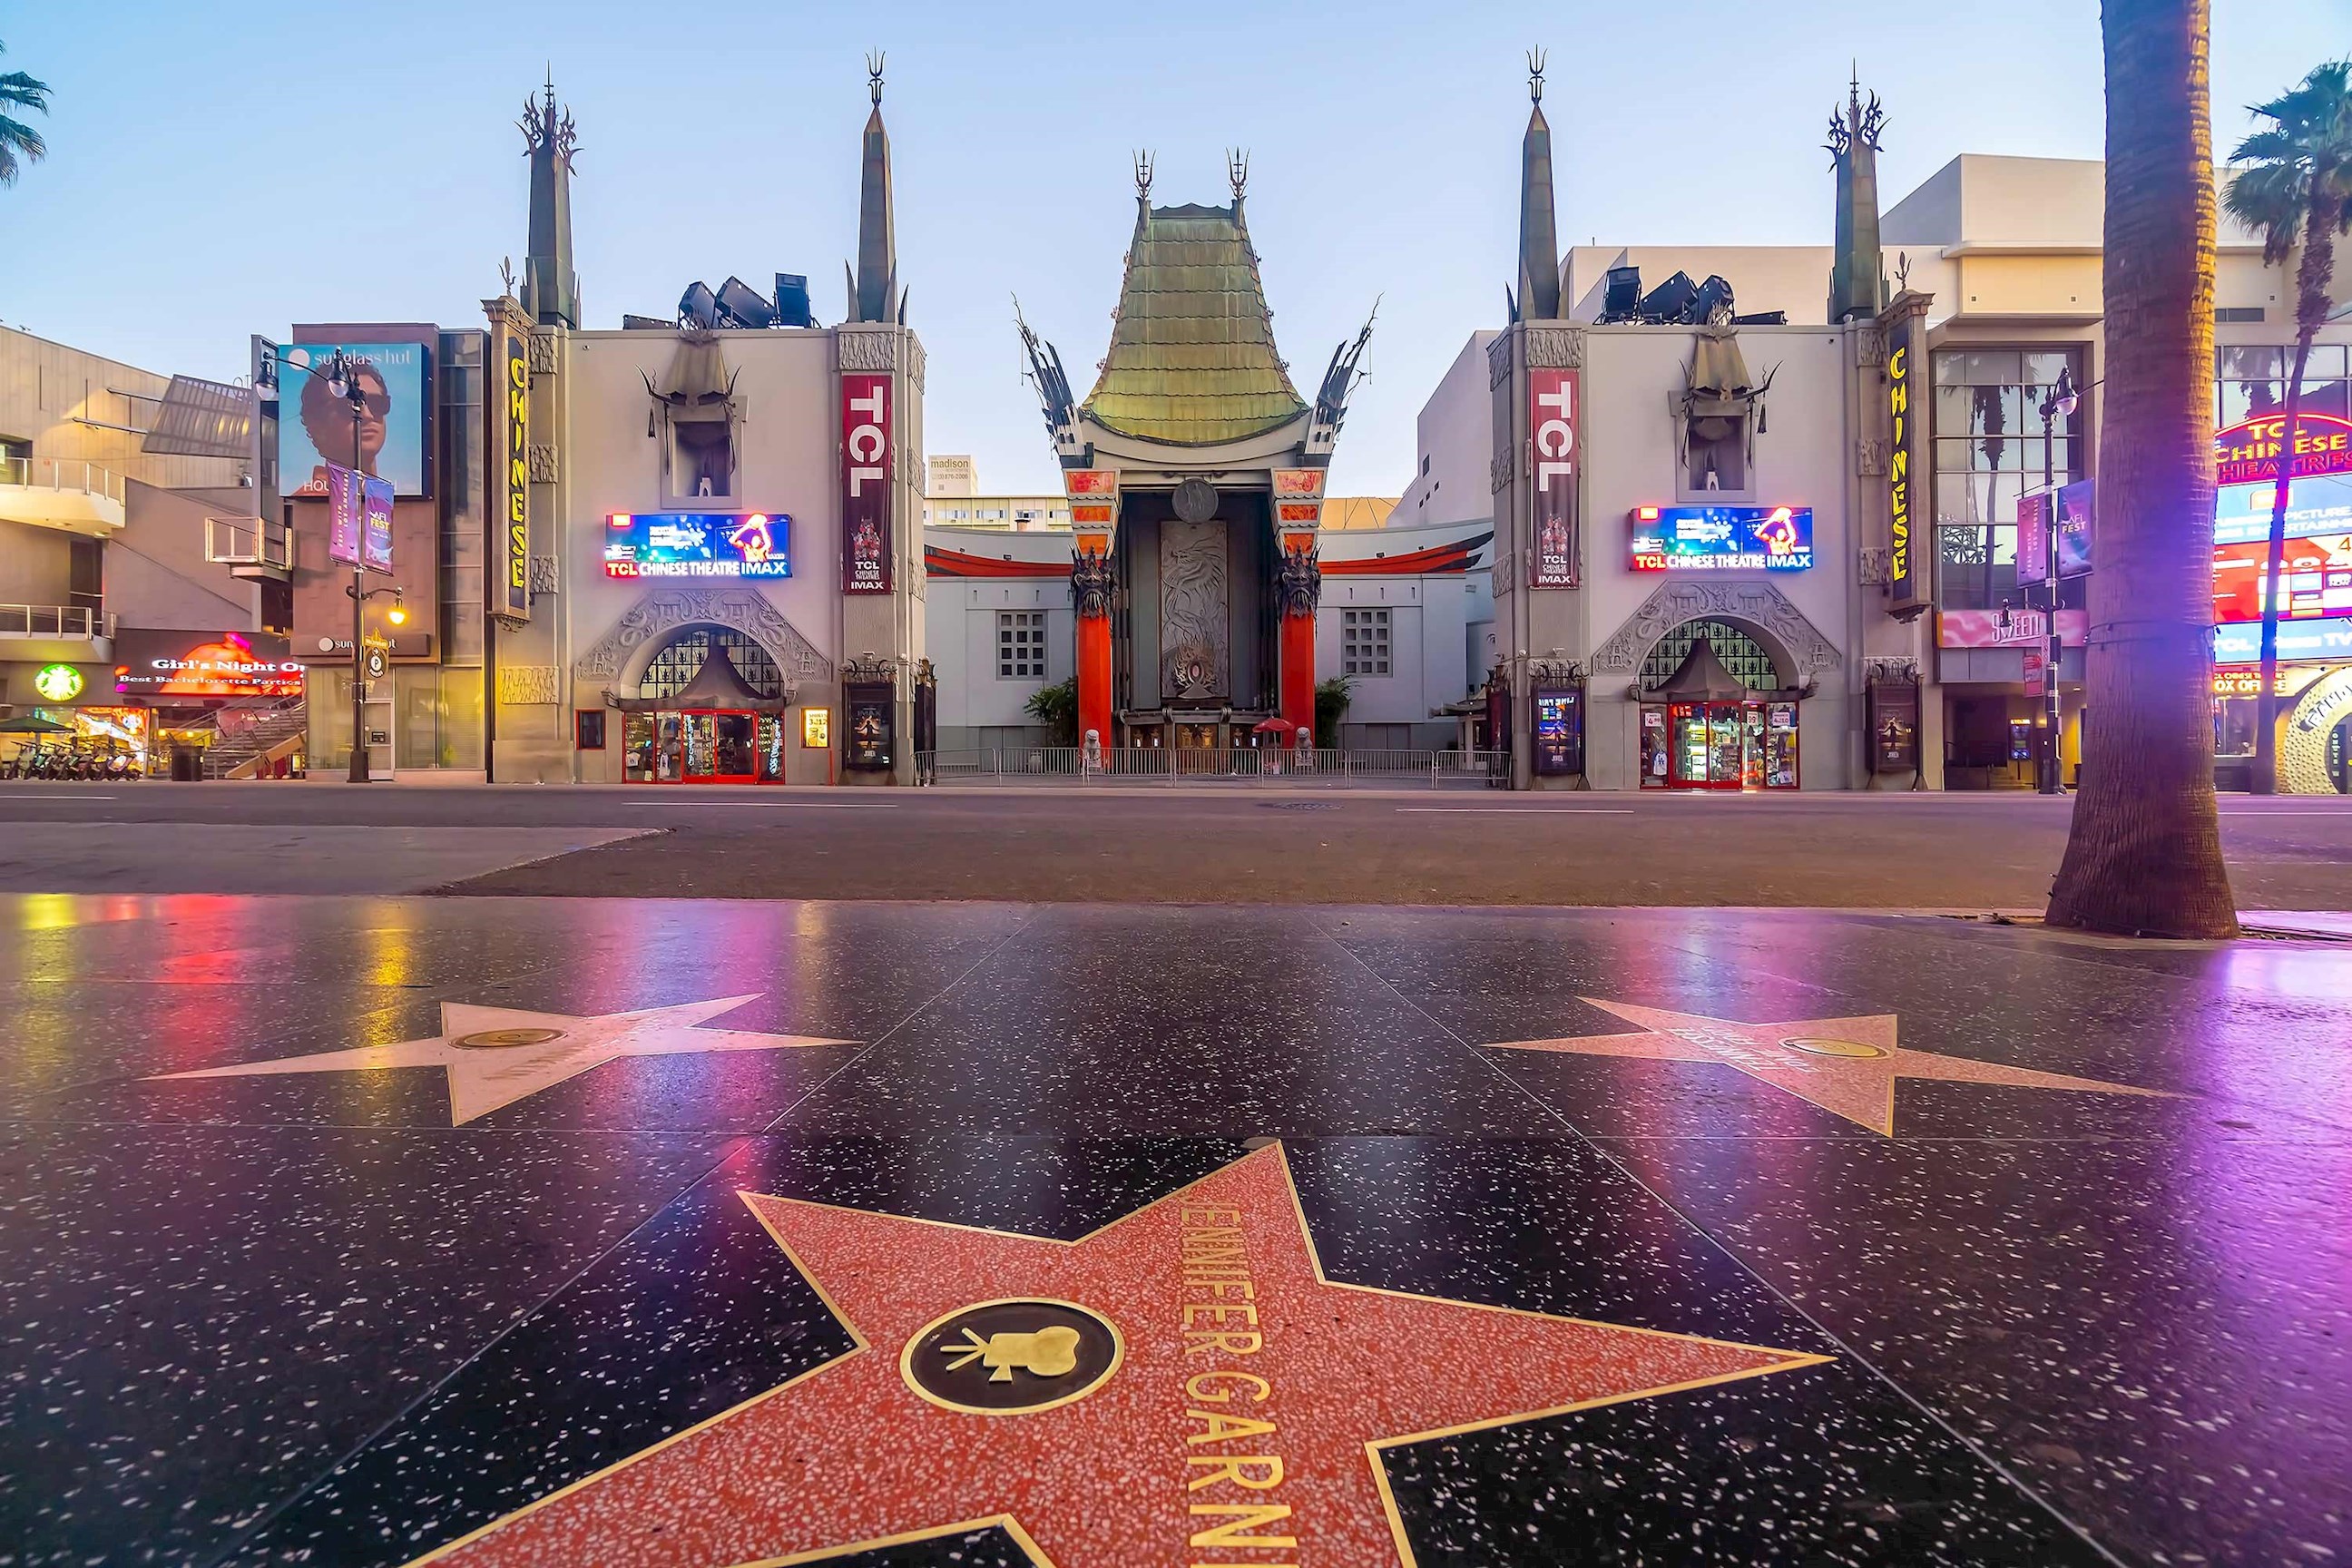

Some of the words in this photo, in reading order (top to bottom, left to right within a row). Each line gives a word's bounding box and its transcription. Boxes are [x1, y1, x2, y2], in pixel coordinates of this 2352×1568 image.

[314, 348, 382, 368] suglass
[385, 348, 412, 364] hut
[1538, 381, 1573, 492] TCL
[2248, 420, 2308, 441] TCL
[849, 386, 885, 497] TCL
[931, 459, 969, 468] madison
[1890, 347, 1907, 581] CHINESE
[511, 358, 524, 588] CHINESE
[370, 517, 390, 531] FEST
[2062, 521, 2087, 534] FEST
[855, 561, 880, 570] TCL
[1543, 555, 1567, 564] TCL
[1636, 556, 1667, 568] TCL
[1667, 554, 1714, 569] CHINESE
[1715, 554, 1765, 569] THEATRE
[1767, 554, 1811, 568] IMAX
[607, 563, 638, 576] TCL
[639, 561, 688, 577] CHINESE
[689, 561, 740, 577] THEATRE
[741, 562, 787, 575] IMAX
[850, 581, 884, 590] IMAX
[1538, 575, 1571, 583] IMAX
[152, 660, 209, 670] Girl's
[215, 661, 277, 673] Night
[119, 675, 156, 683] Best
[156, 676, 249, 685] Bachelorette
[251, 678, 301, 686] Parties
[2214, 679, 2236, 692] OX
[1181, 1195, 1263, 1355] JENNIFER
[1186, 1371, 1301, 1568] GARN
